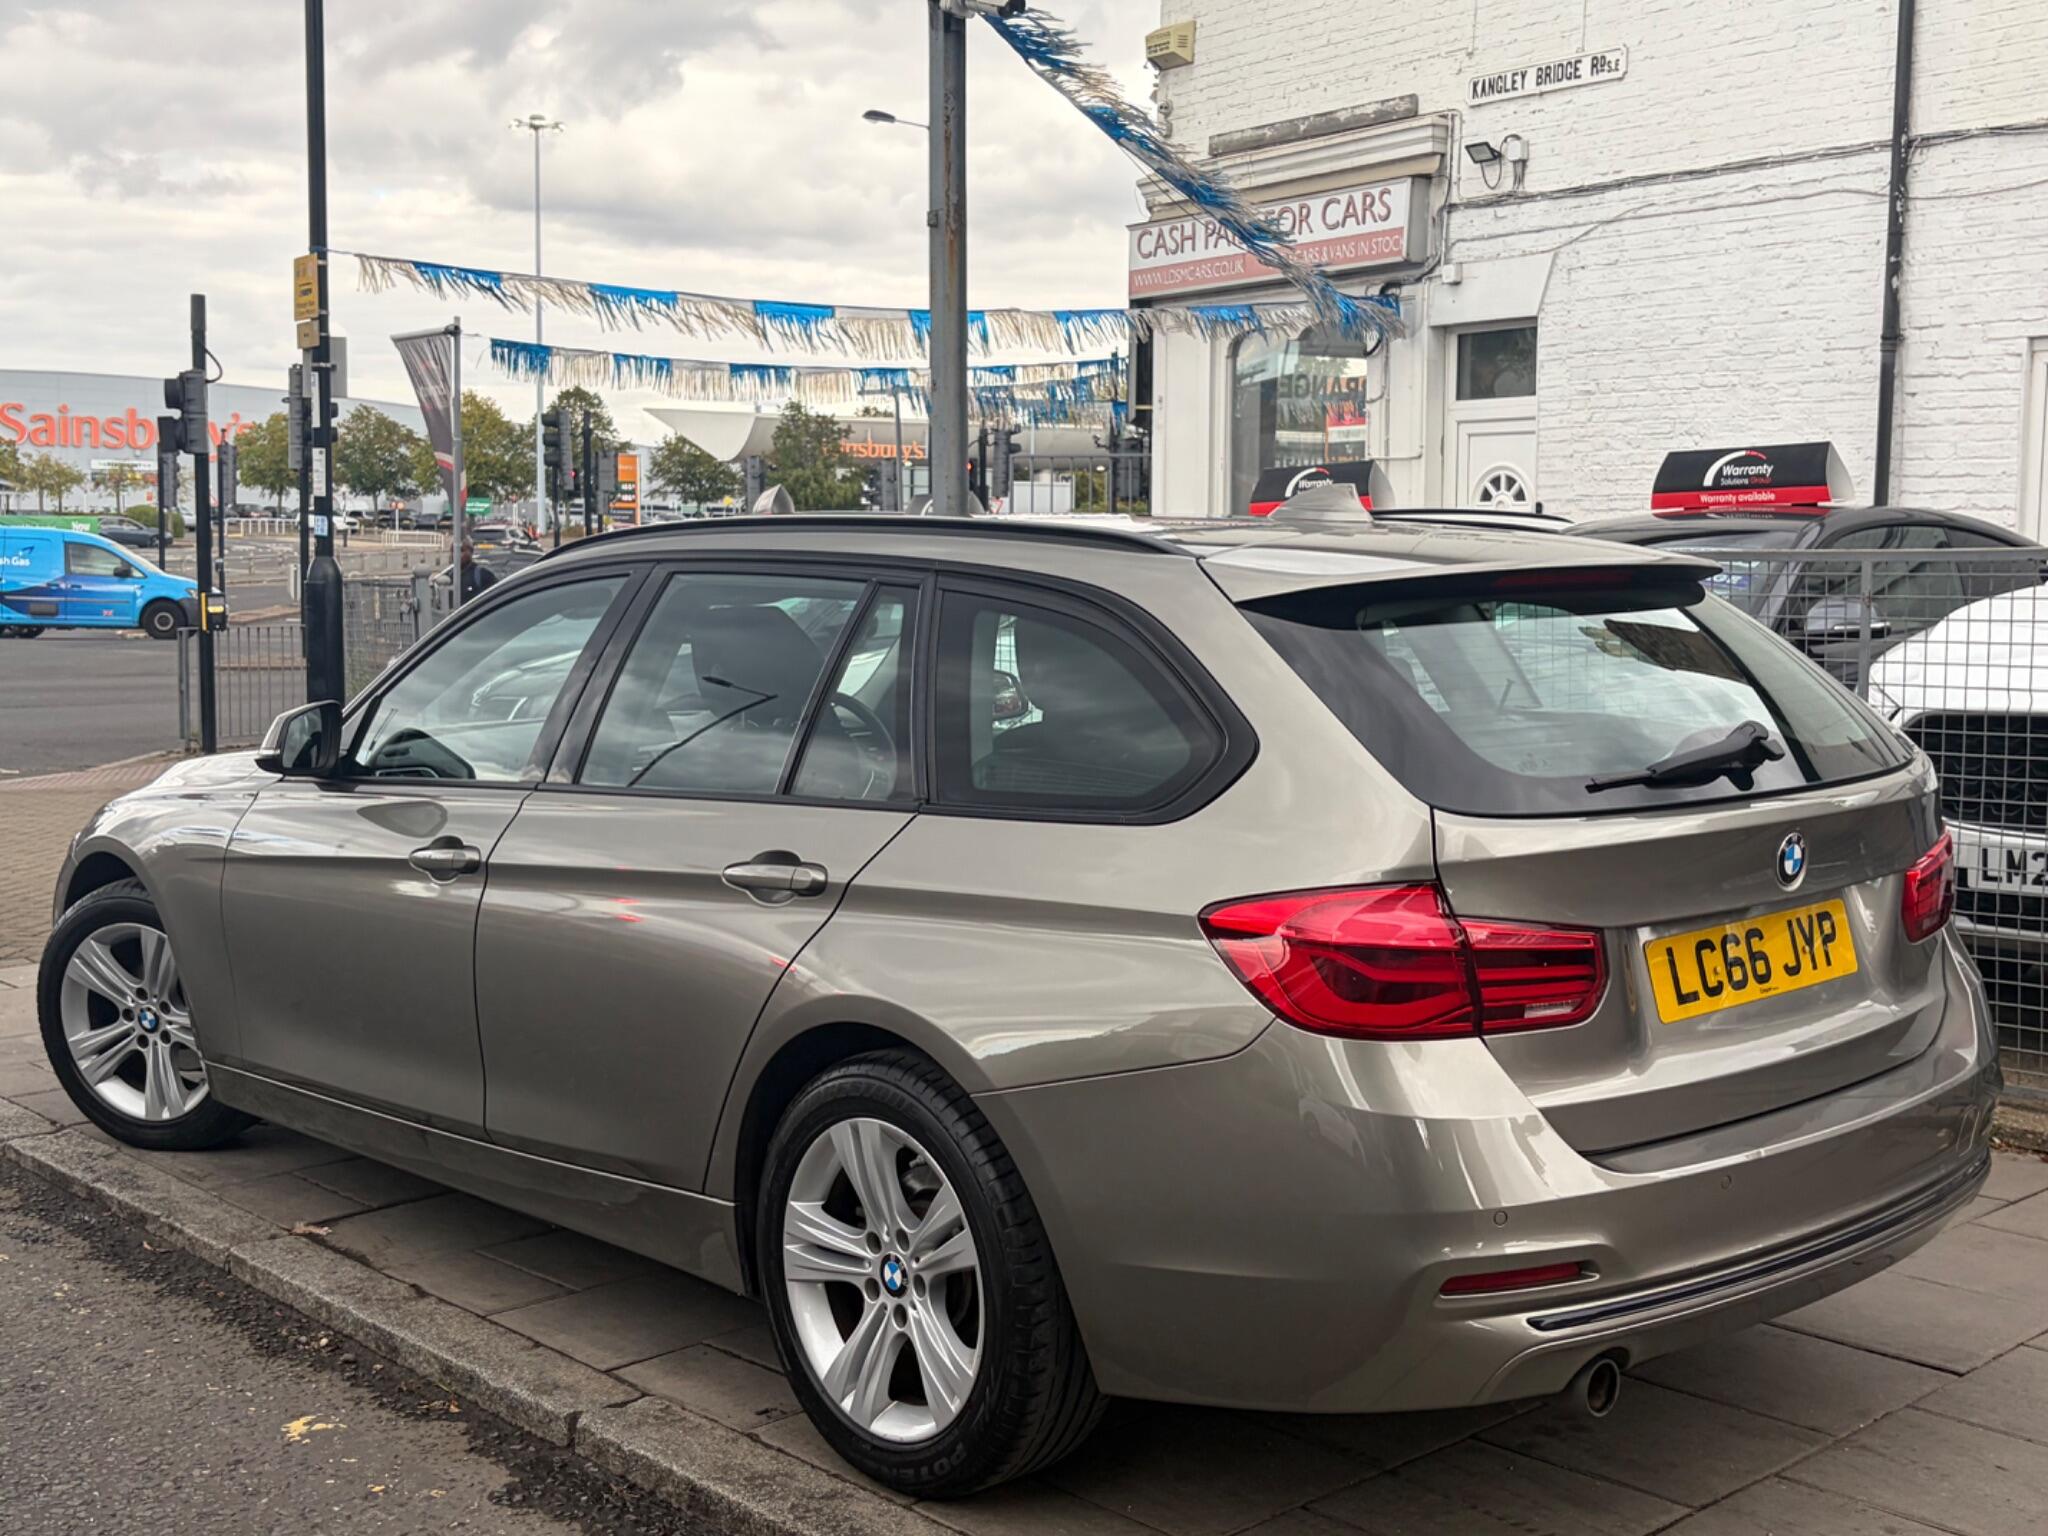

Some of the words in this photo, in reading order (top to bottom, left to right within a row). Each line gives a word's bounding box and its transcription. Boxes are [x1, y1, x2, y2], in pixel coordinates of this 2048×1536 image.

[1472, 69, 1528, 99] KANGLEY
[1536, 59, 1582, 87] BRIDGE
[1137, 221, 1197, 260] CASH
[1204, 219, 1246, 250] PA
[1321, 187, 1392, 231] CARS
[1329, 242, 1356, 259] VANS
[1357, 239, 1369, 256] IN
[0, 403, 256, 462] Sainsby'
[1720, 477, 1749, 486] Solutions
[1722, 464, 1774, 477] Warranty
[1700, 494, 1737, 504] Warranty
[1738, 490, 1776, 502] available
[1666, 927, 1772, 1006] LC66
[1783, 910, 1837, 977] JYP
